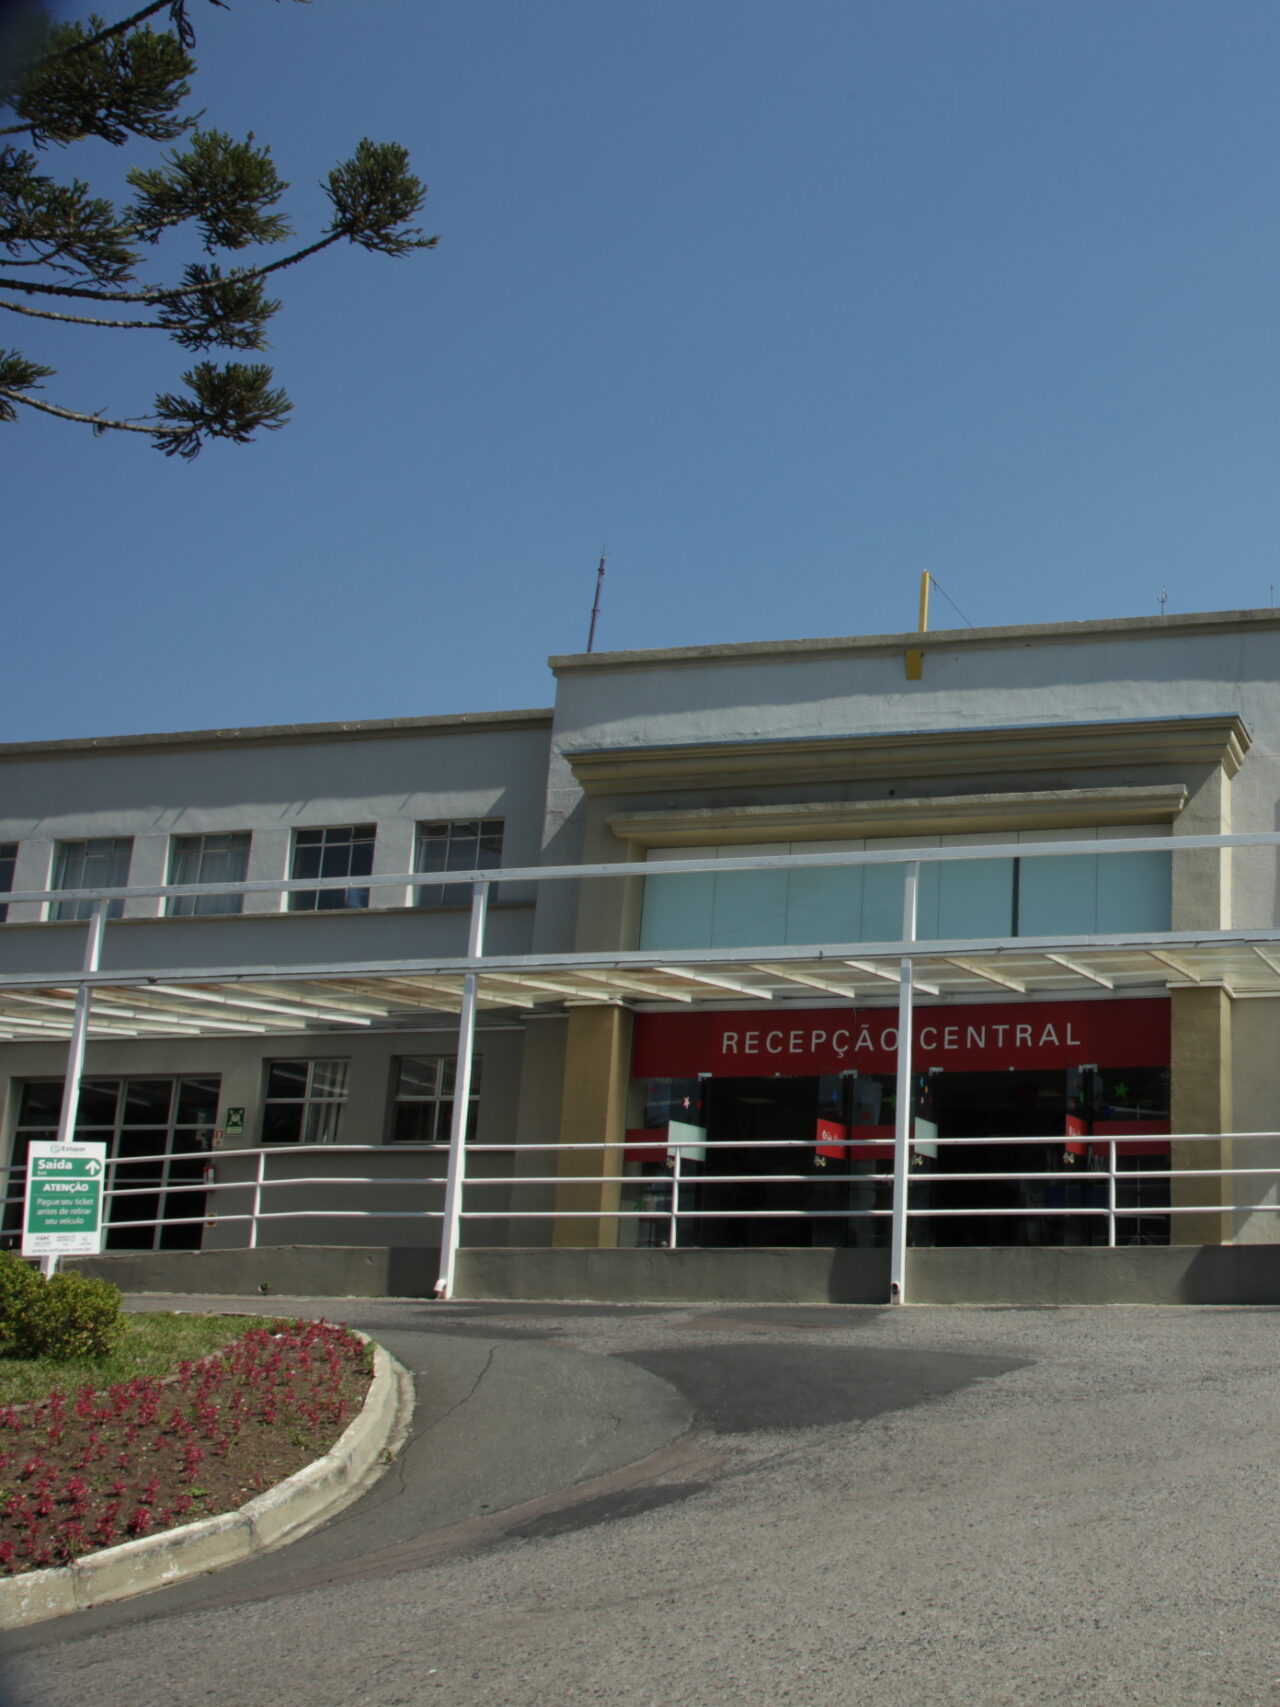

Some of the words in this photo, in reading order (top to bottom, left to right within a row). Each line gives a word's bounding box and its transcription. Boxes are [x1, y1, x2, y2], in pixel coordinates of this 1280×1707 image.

[721, 1024, 900, 1058] RECEPÇÃO
[919, 1022, 1082, 1050] CENTRAL
[37, 1159, 73, 1170] Saída
[43, 1182, 89, 1193] ATENÇÃO
[37, 1198, 60, 1207] Pague
[74, 1198, 94, 1206] ticket
[59, 1207, 69, 1215] de
[70, 1207, 92, 1215] retirar
[59, 1217, 84, 1225] veículo
